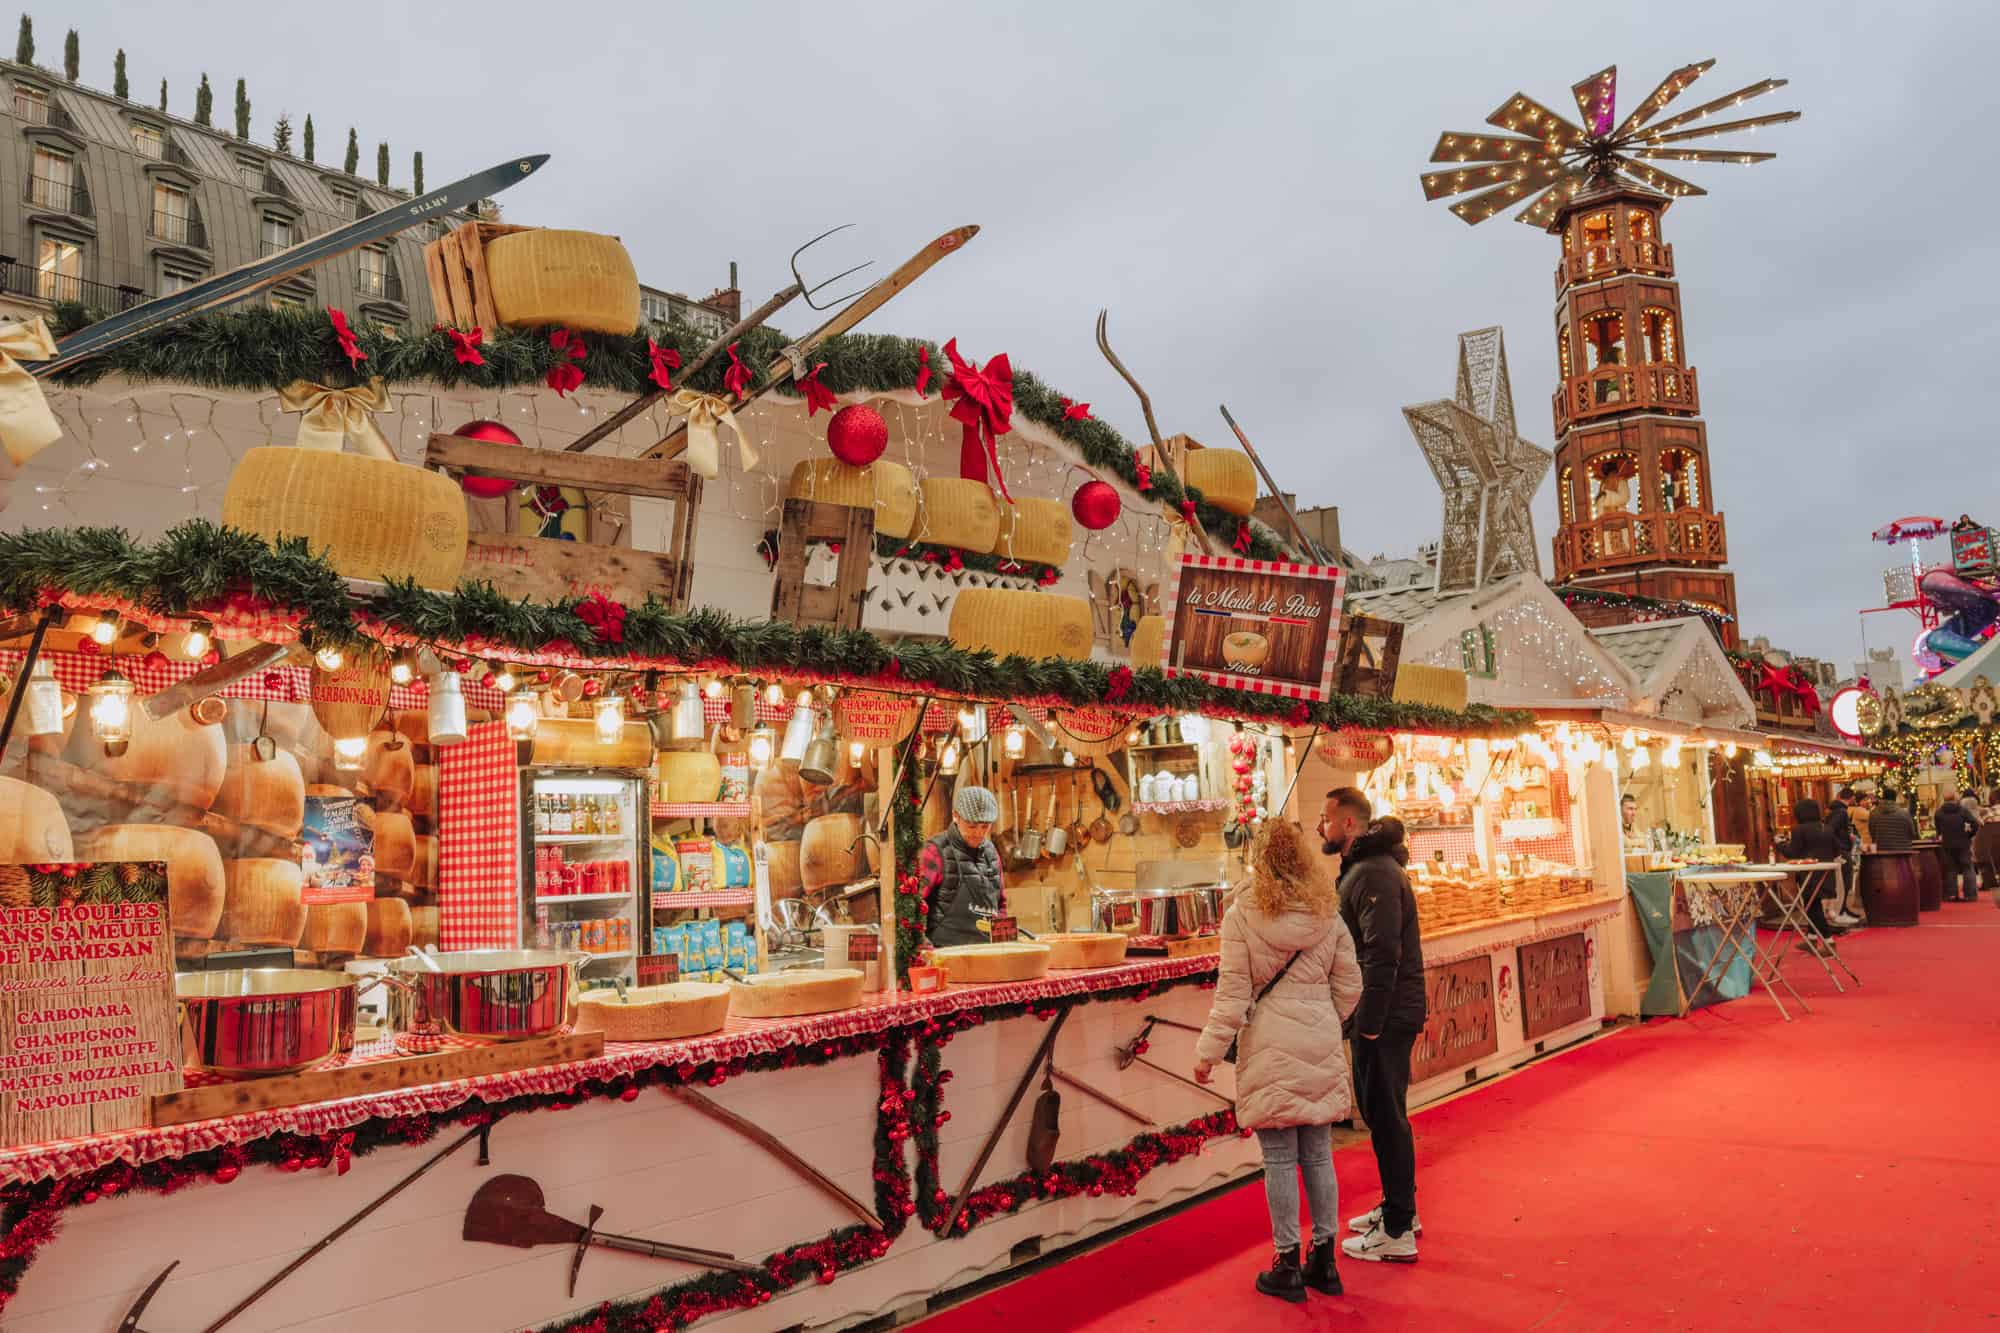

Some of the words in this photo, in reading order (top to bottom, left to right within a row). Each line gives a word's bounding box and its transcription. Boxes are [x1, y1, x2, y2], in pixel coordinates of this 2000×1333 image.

[1205, 587, 1256, 610] Meule
[1258, 594, 1277, 613] de
[1280, 594, 1320, 618] Paris
[839, 698, 908, 712] CHAMPIGNON
[884, 713, 897, 726] DE
[853, 726, 891, 738] TRUFFE
[57, 900, 160, 922] ROULÉES
[51, 926, 82, 942] SA
[87, 921, 163, 940] MEULE
[28, 941, 154, 964] PARMESAN
[3, 975, 68, 992] sauces
[76, 974, 113, 985] aux
[1433, 973, 1488, 1010] Maison
[16, 1003, 133, 1025] CARBONARA
[14, 1025, 137, 1050] CHAMPIGNON
[1440, 1011, 1489, 1058] Panini
[61, 1048, 88, 1063] DE
[90, 1041, 159, 1060] TRUFFE
[68, 1059, 176, 1084] MOZZARELA
[16, 1085, 142, 1113] NAPOLITAINE
